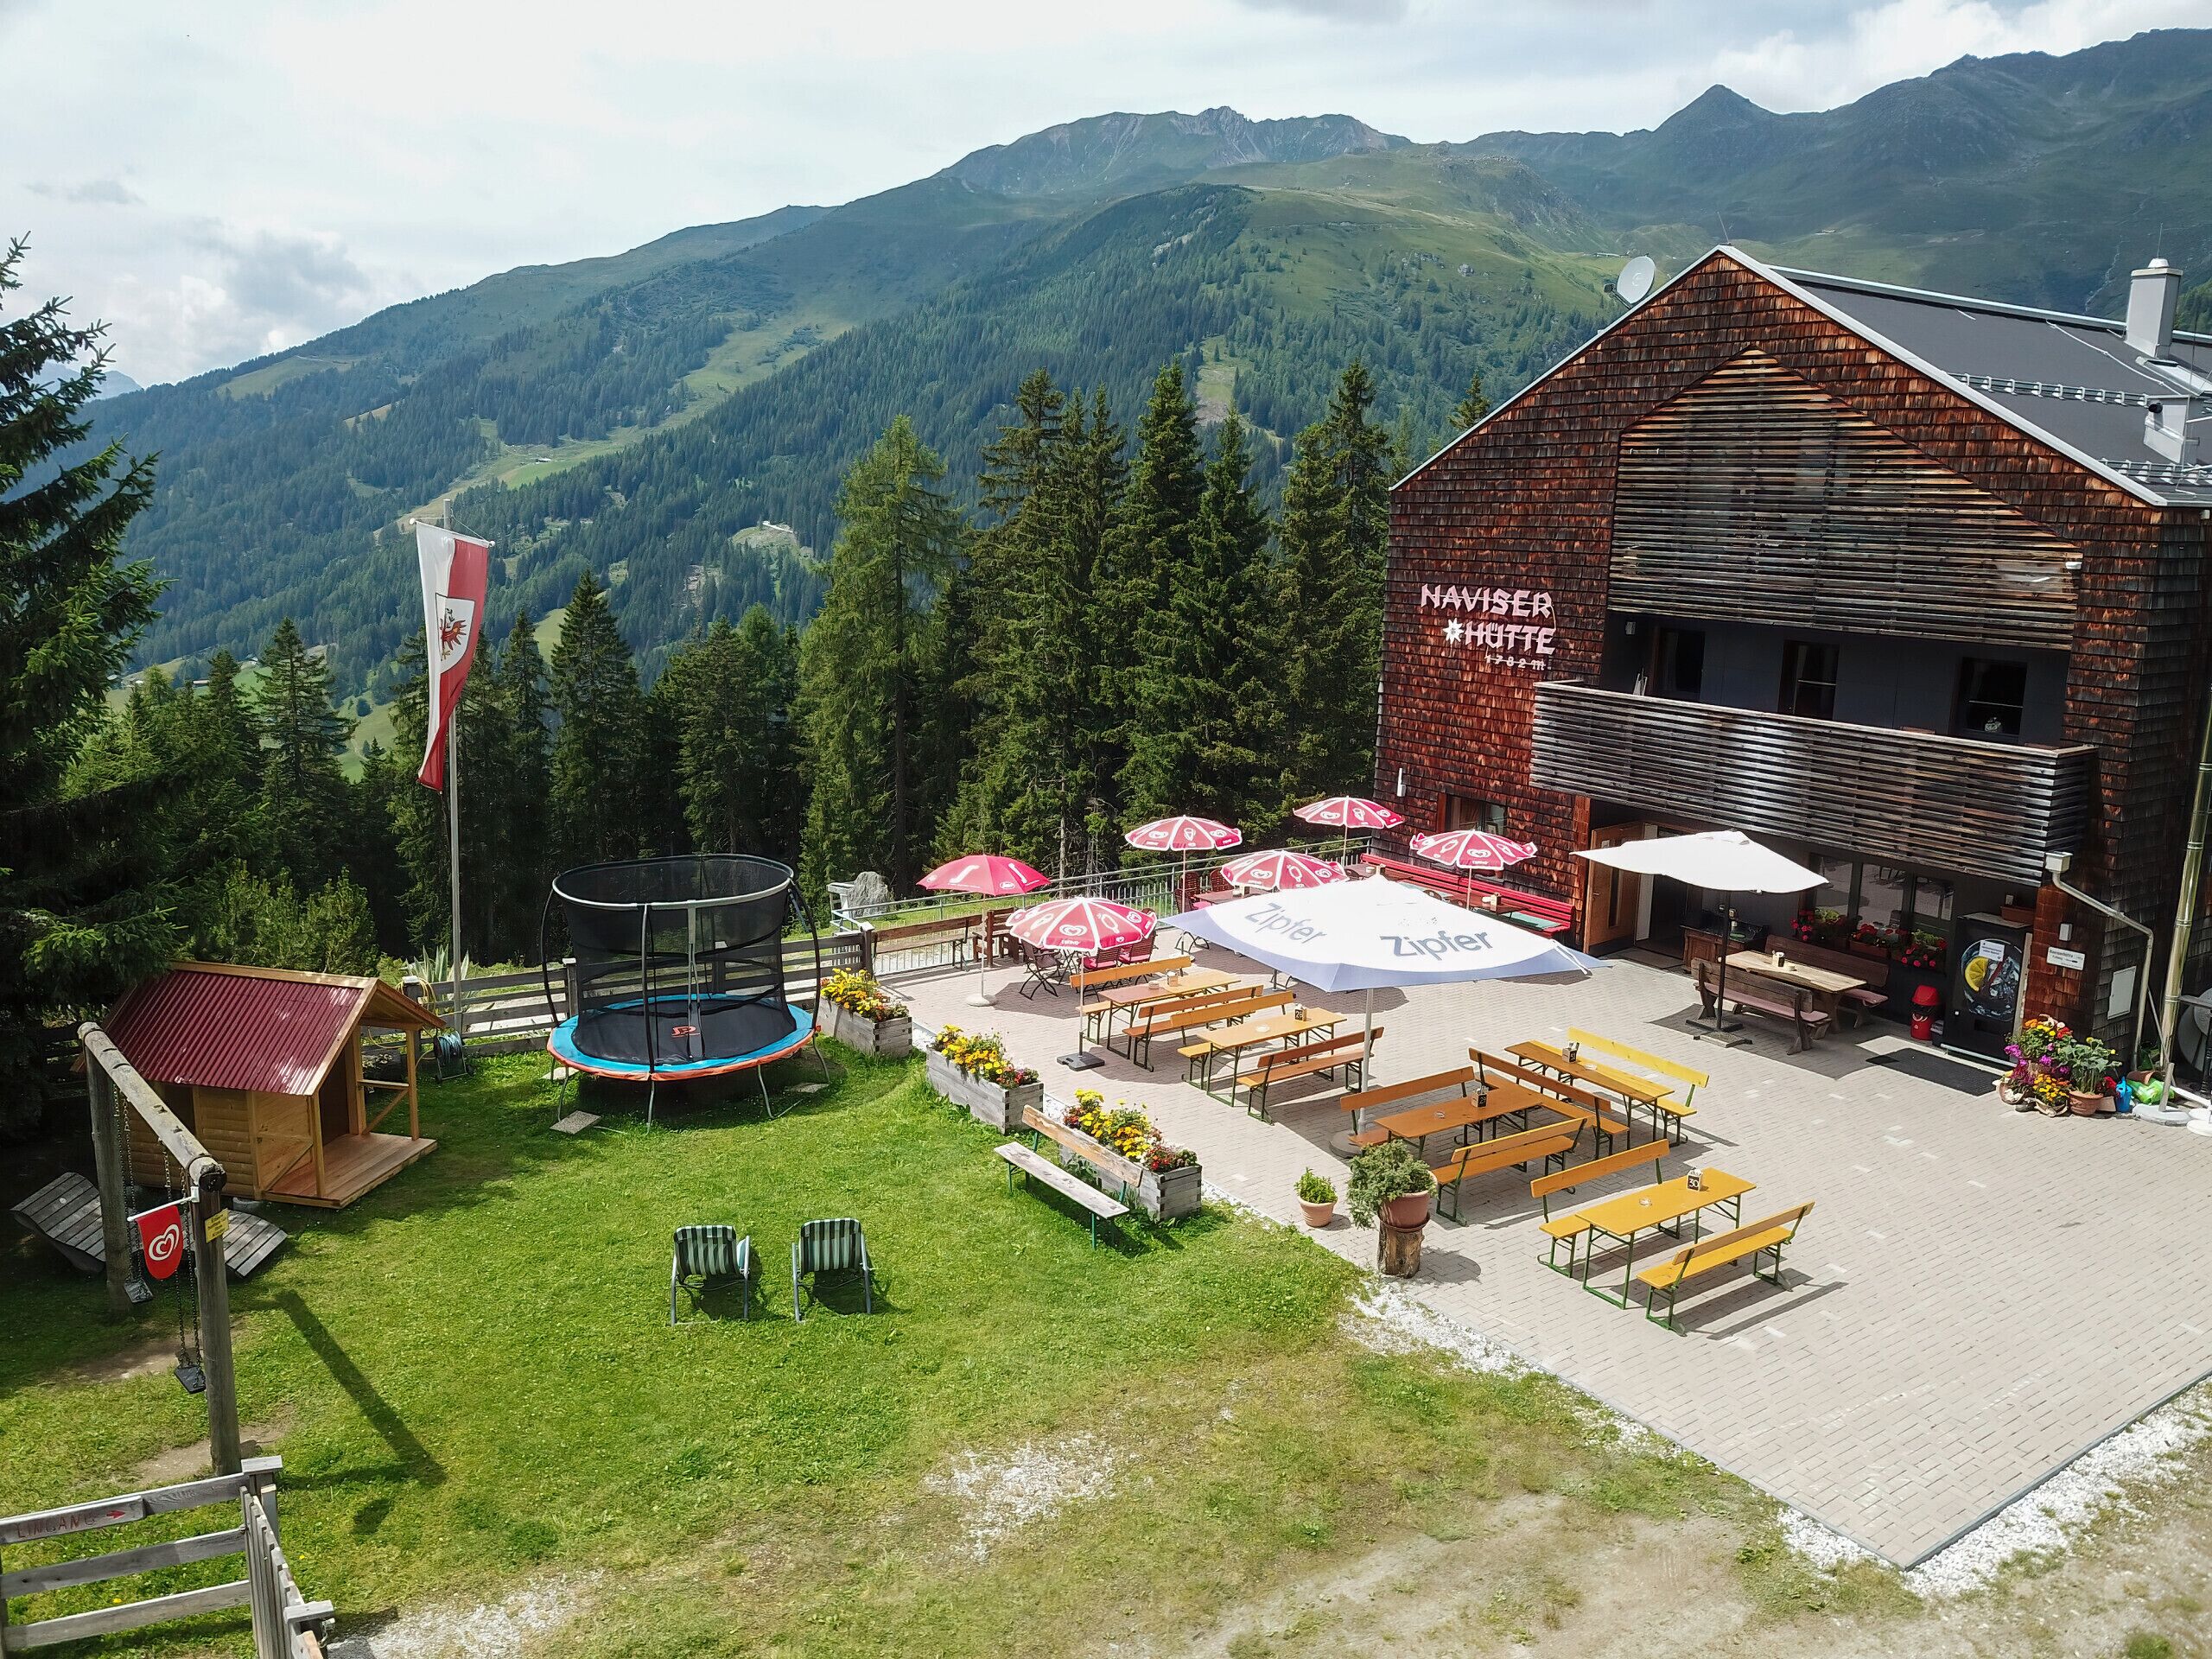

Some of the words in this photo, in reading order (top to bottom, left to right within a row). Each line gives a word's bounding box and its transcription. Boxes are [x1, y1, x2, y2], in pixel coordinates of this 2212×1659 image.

[1421, 583, 1554, 619] NAVISER
[1465, 620, 1556, 655] HÜTTE
[1244, 902, 1328, 944] Zipfer
[1379, 931, 1493, 961] Zipfer
[1688, 1179, 1699, 1188] 30
